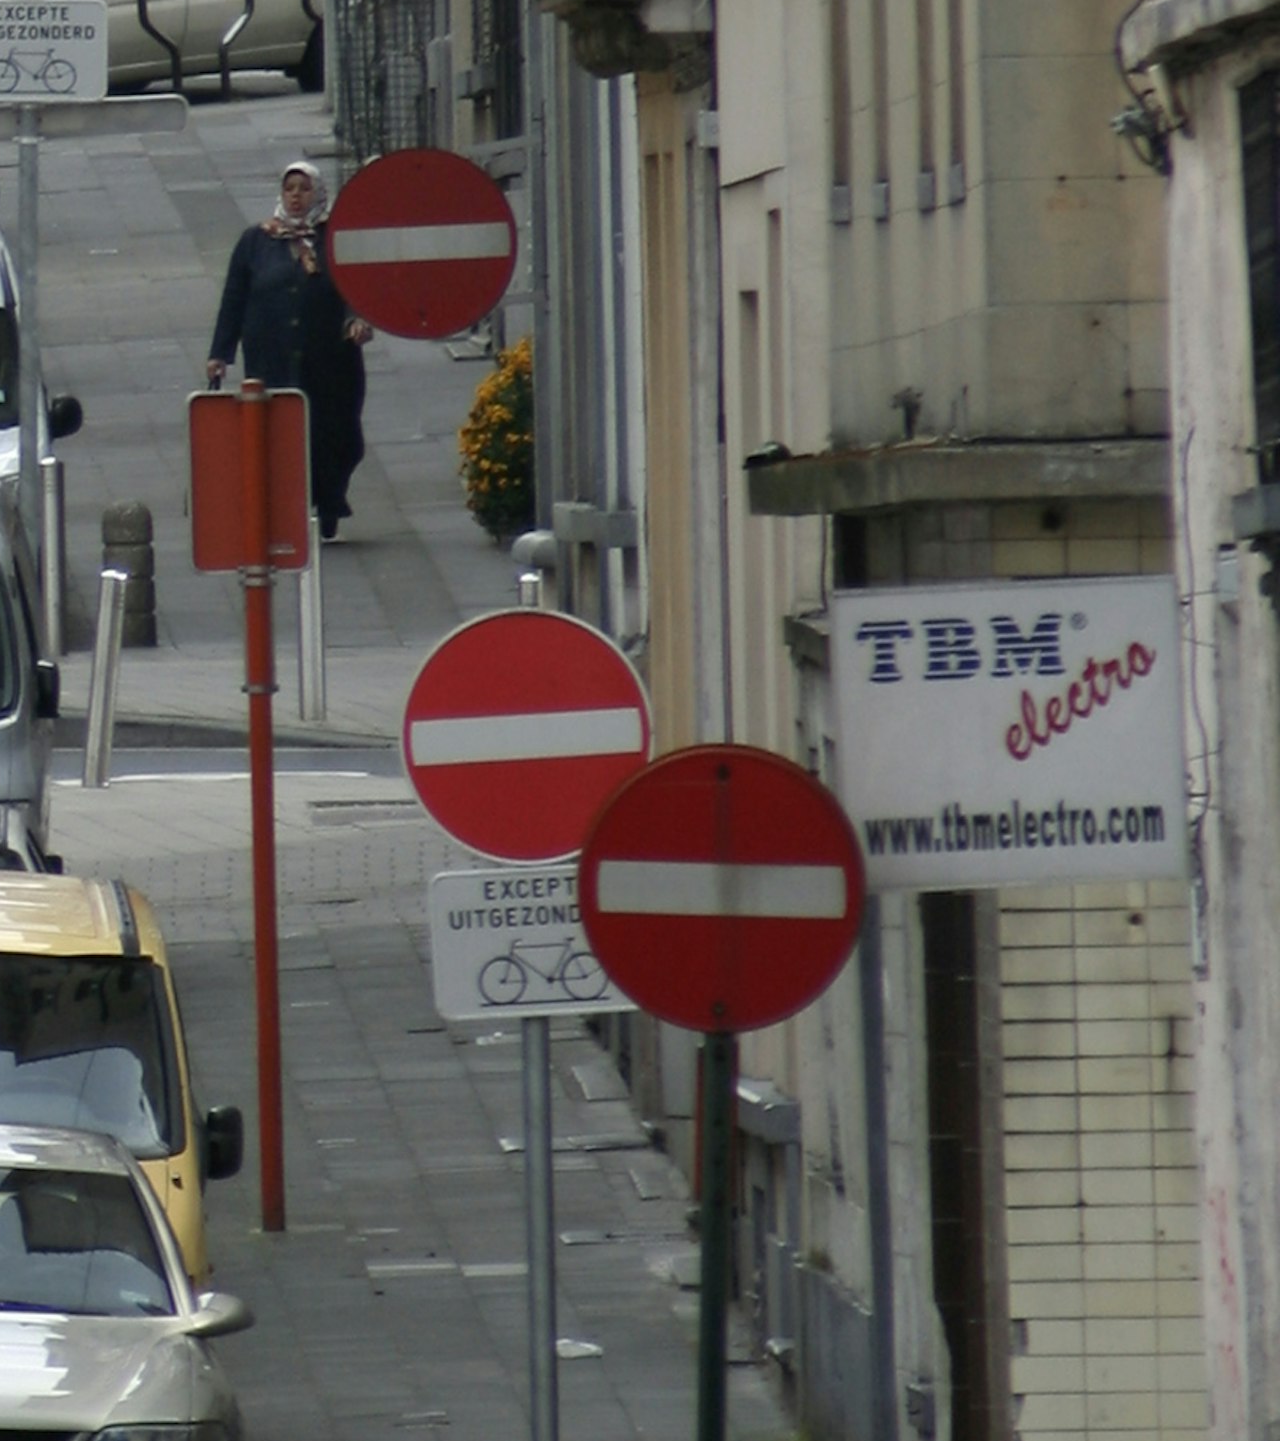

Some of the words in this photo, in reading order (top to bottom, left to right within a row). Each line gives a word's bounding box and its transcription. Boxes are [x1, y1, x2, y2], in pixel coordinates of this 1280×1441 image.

[855, 613, 1067, 684] TBM
[1004, 641, 1157, 761] electro
[864, 799, 1166, 856] www.tbmelectro.com
[448, 903, 582, 931] UITGEZOND
[483, 876, 578, 901] EXCEPT
